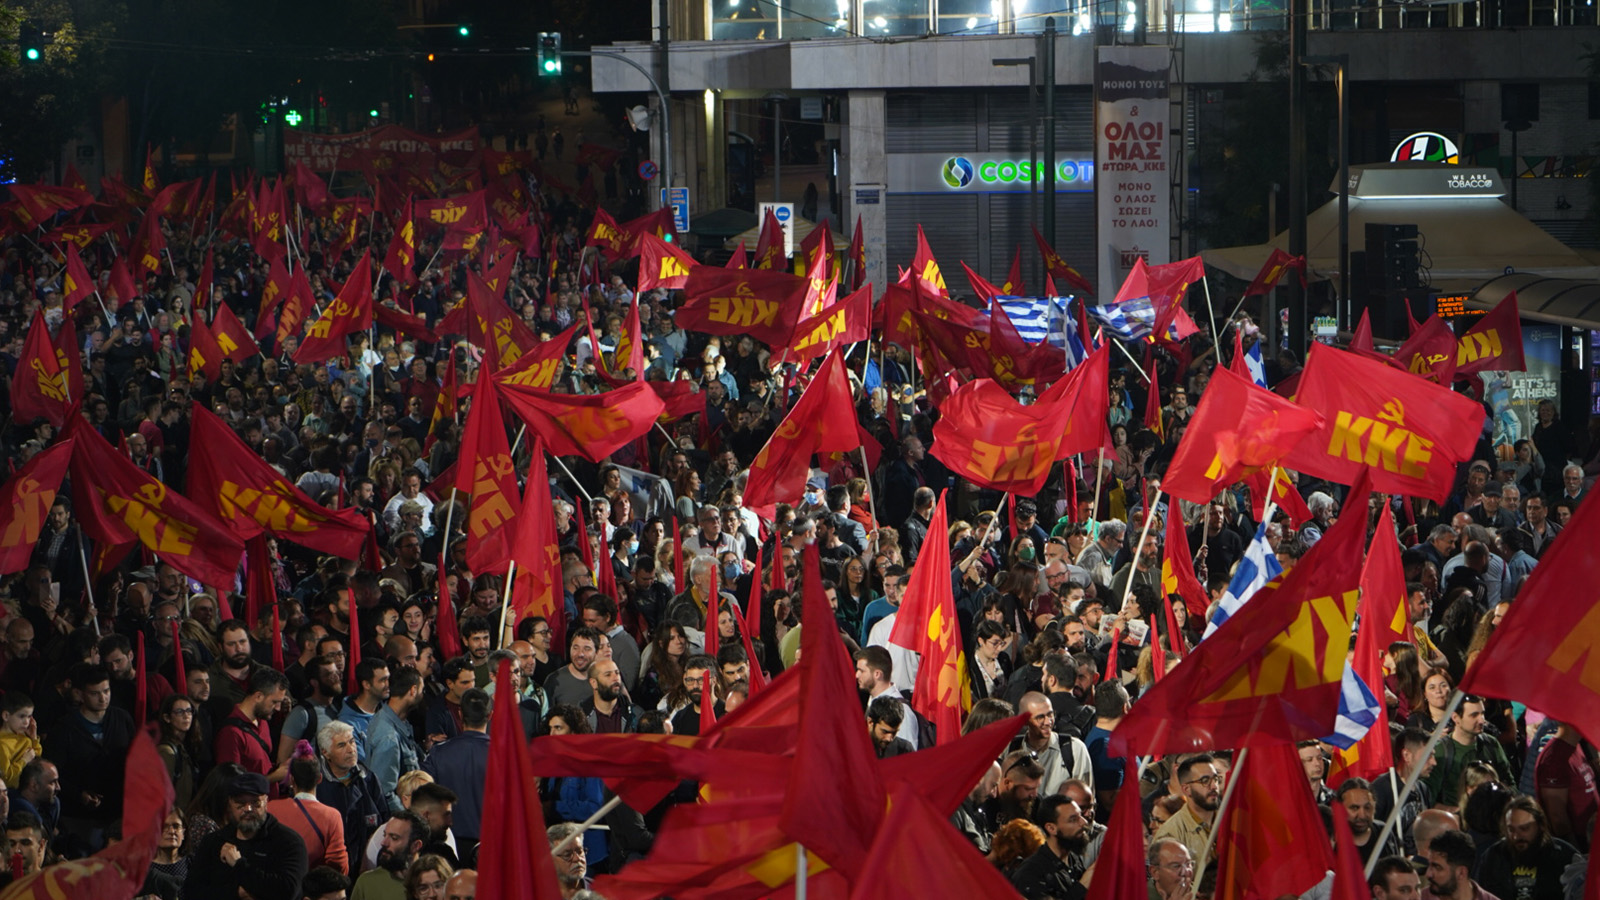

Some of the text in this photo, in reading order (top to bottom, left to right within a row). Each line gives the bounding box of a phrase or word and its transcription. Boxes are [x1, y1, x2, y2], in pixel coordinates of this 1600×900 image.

[1102, 80, 1165, 89] ΜΟΝΟΙ ΤΟΥΣ
[1129, 105, 1139, 116] &
[1104, 121, 1163, 141] ΟΛΟΙ
[1108, 142, 1161, 160] ΜΑΣ
[1102, 162, 1166, 173] #ΤΩΡΑ_ΚΚΕ
[1118, 182, 1152, 191] ΜΟΝΟ
[1113, 195, 1157, 203] Ο ΛΑΟΣ
[1118, 207, 1151, 215] ΣΩΖΕΙ
[1112, 219, 1158, 228] ΤΟ ΛΑΟ!
[659, 256, 690, 280] ΚΚ
[1512, 378, 1544, 389] LET'S
[1512, 387, 1558, 399] ATHENS
[1327, 410, 1435, 480] ΚΚΕ
